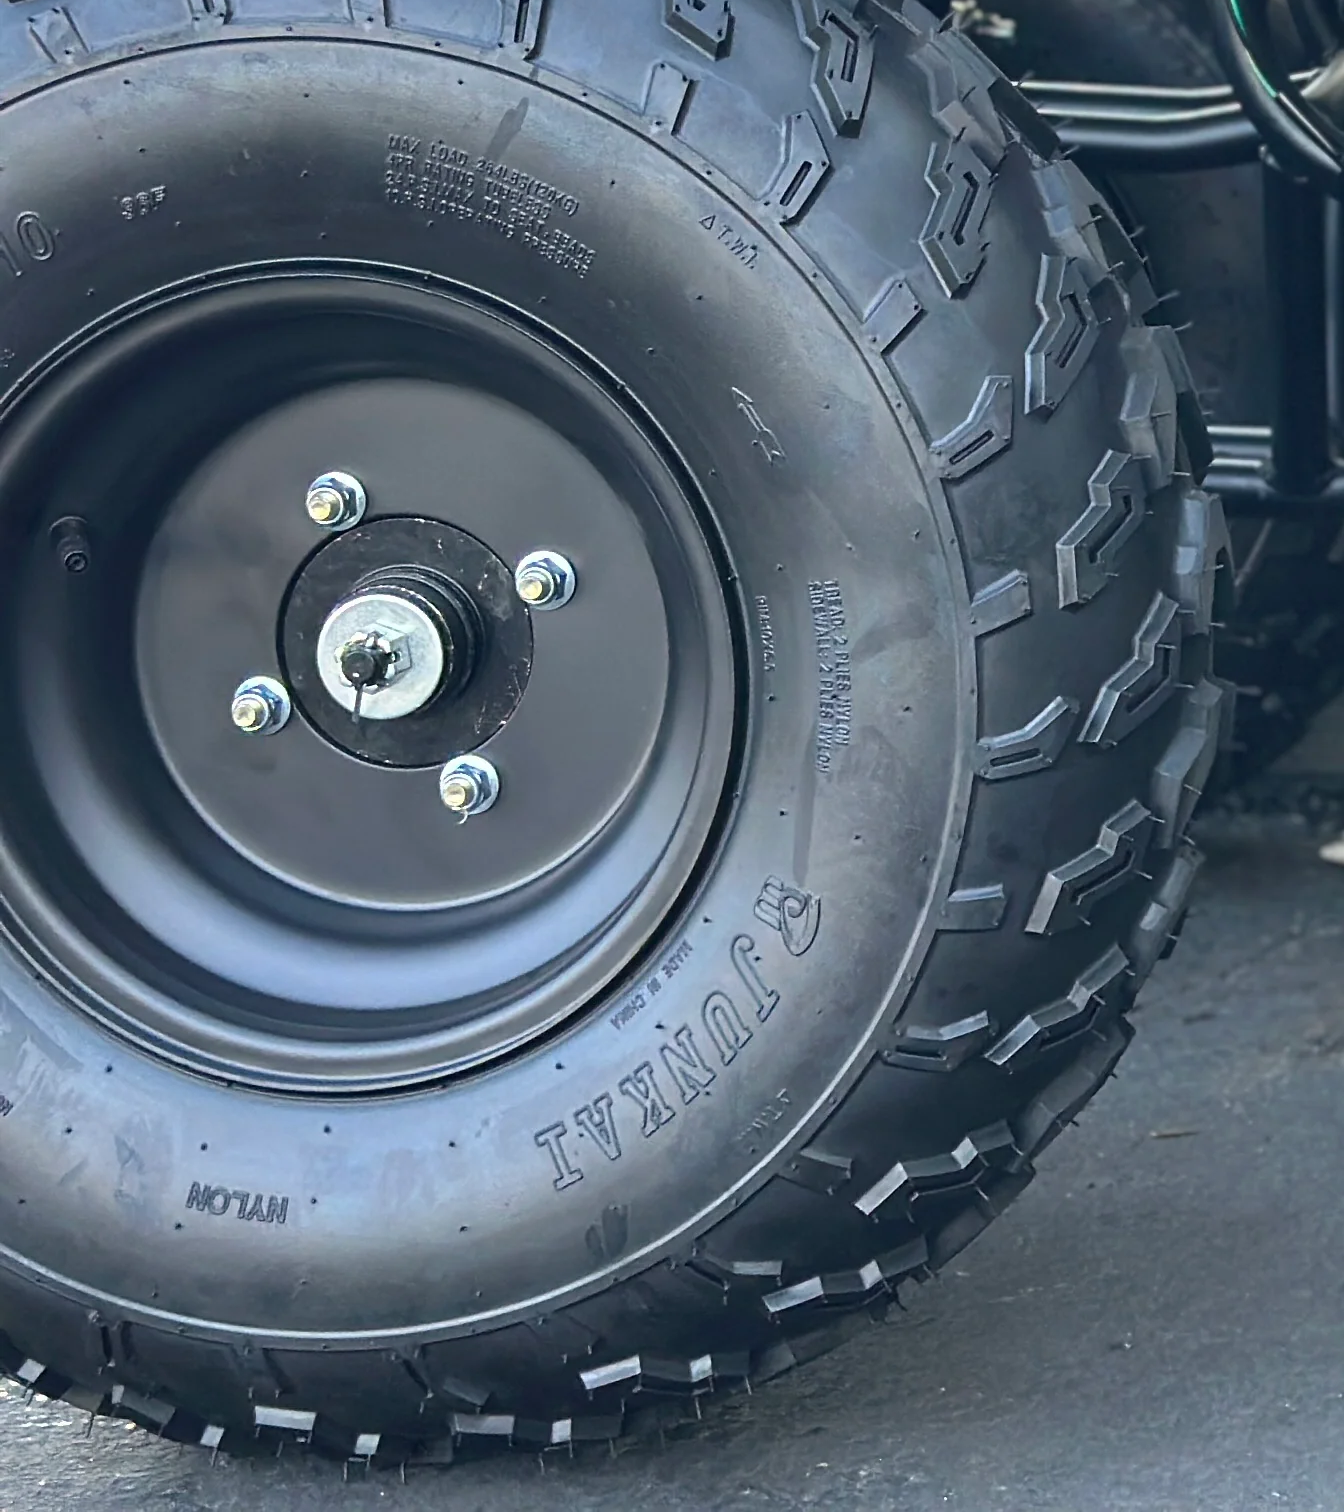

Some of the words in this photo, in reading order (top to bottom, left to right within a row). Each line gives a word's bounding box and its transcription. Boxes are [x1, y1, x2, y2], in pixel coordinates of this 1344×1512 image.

[833, 635, 849, 648] 2
[818, 662, 833, 674] 2
[834, 651, 852, 691] PLIES
[661, 940, 695, 980] MADE
[534, 934, 780, 1191] JUNKAI
[185, 1180, 289, 1225] NYLON
